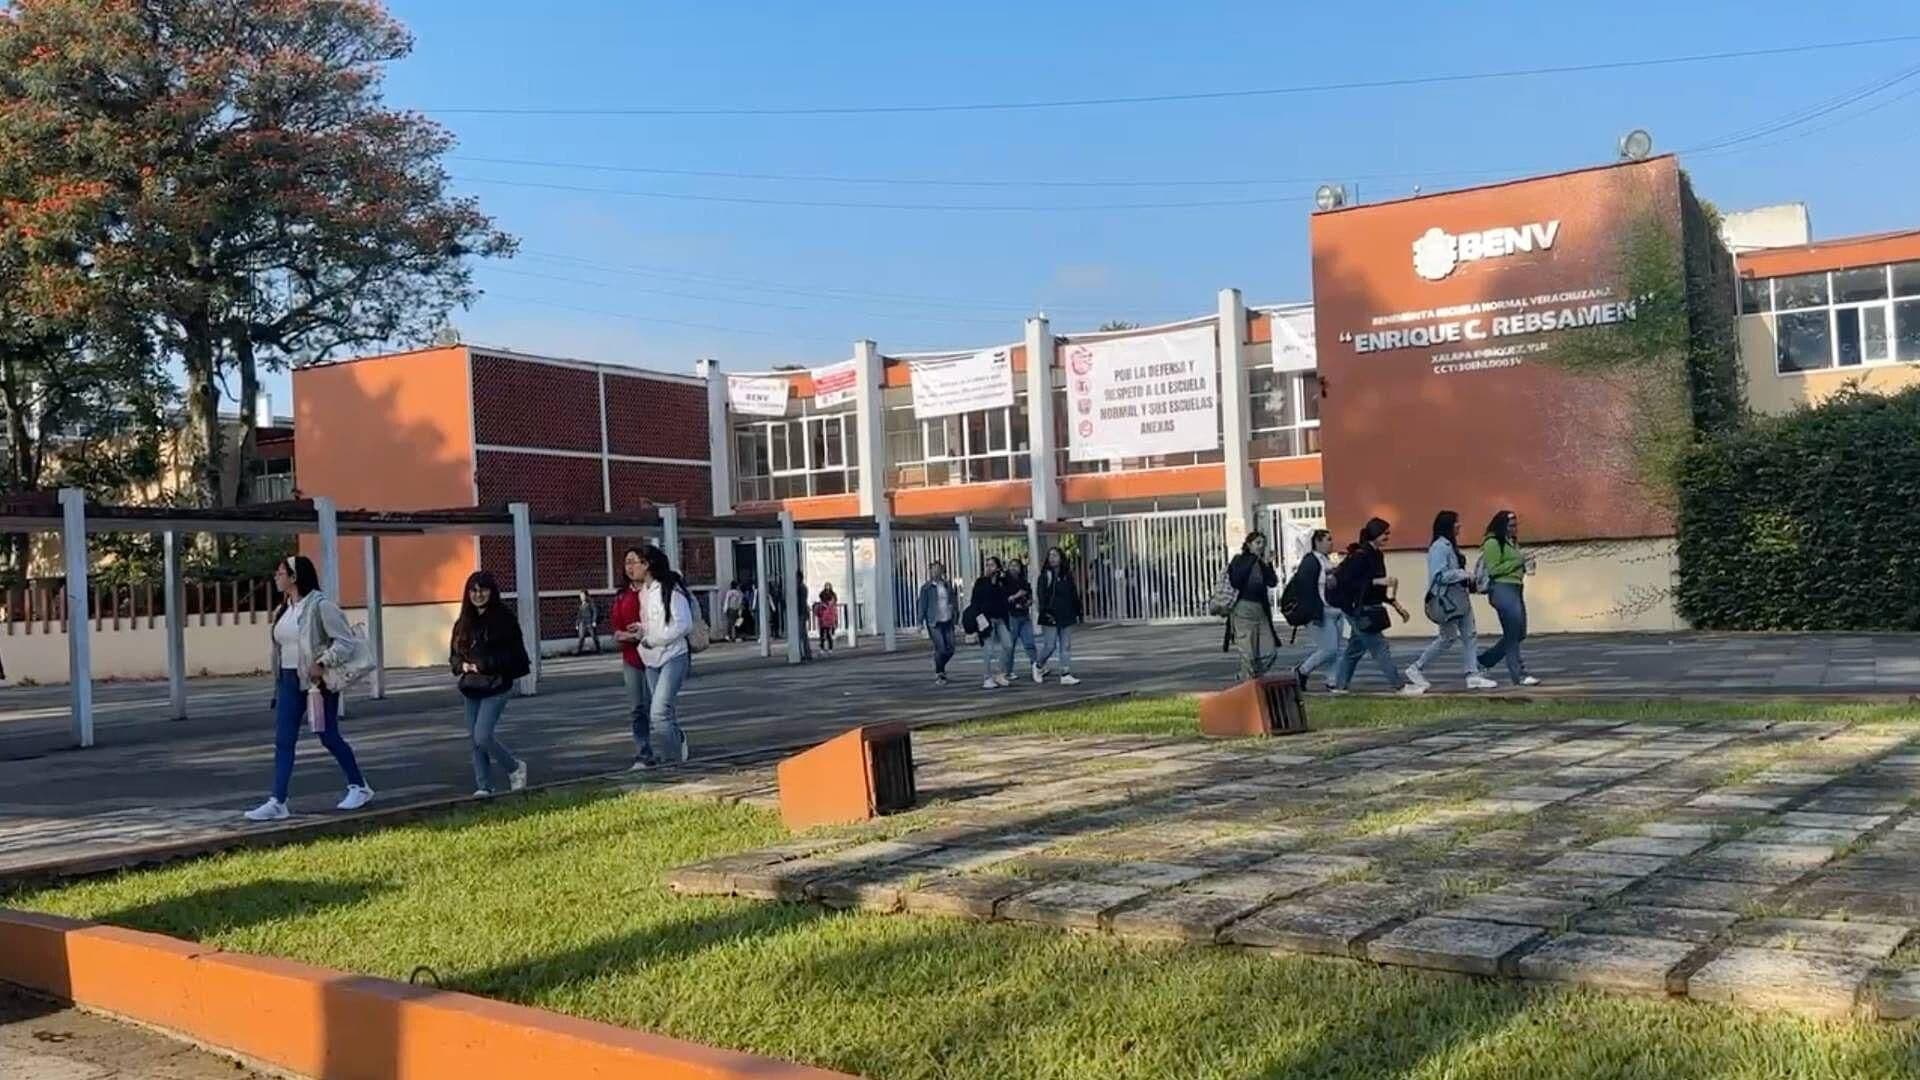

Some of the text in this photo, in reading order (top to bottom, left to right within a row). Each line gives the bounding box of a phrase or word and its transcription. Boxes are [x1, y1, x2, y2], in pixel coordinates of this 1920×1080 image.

[1458, 221, 1561, 261] BENV
[1482, 299, 1528, 312] NORMAL
[1432, 351, 1472, 364] XALAPA
[1114, 360, 1194, 382] POR LA DEFENSA Y
[1103, 377, 1206, 402] RESPETO A LA ESCUELA
[1099, 396, 1213, 420] NORMAL Y SUS ESCUELAS
[1140, 420, 1174, 435] ANEXAS
